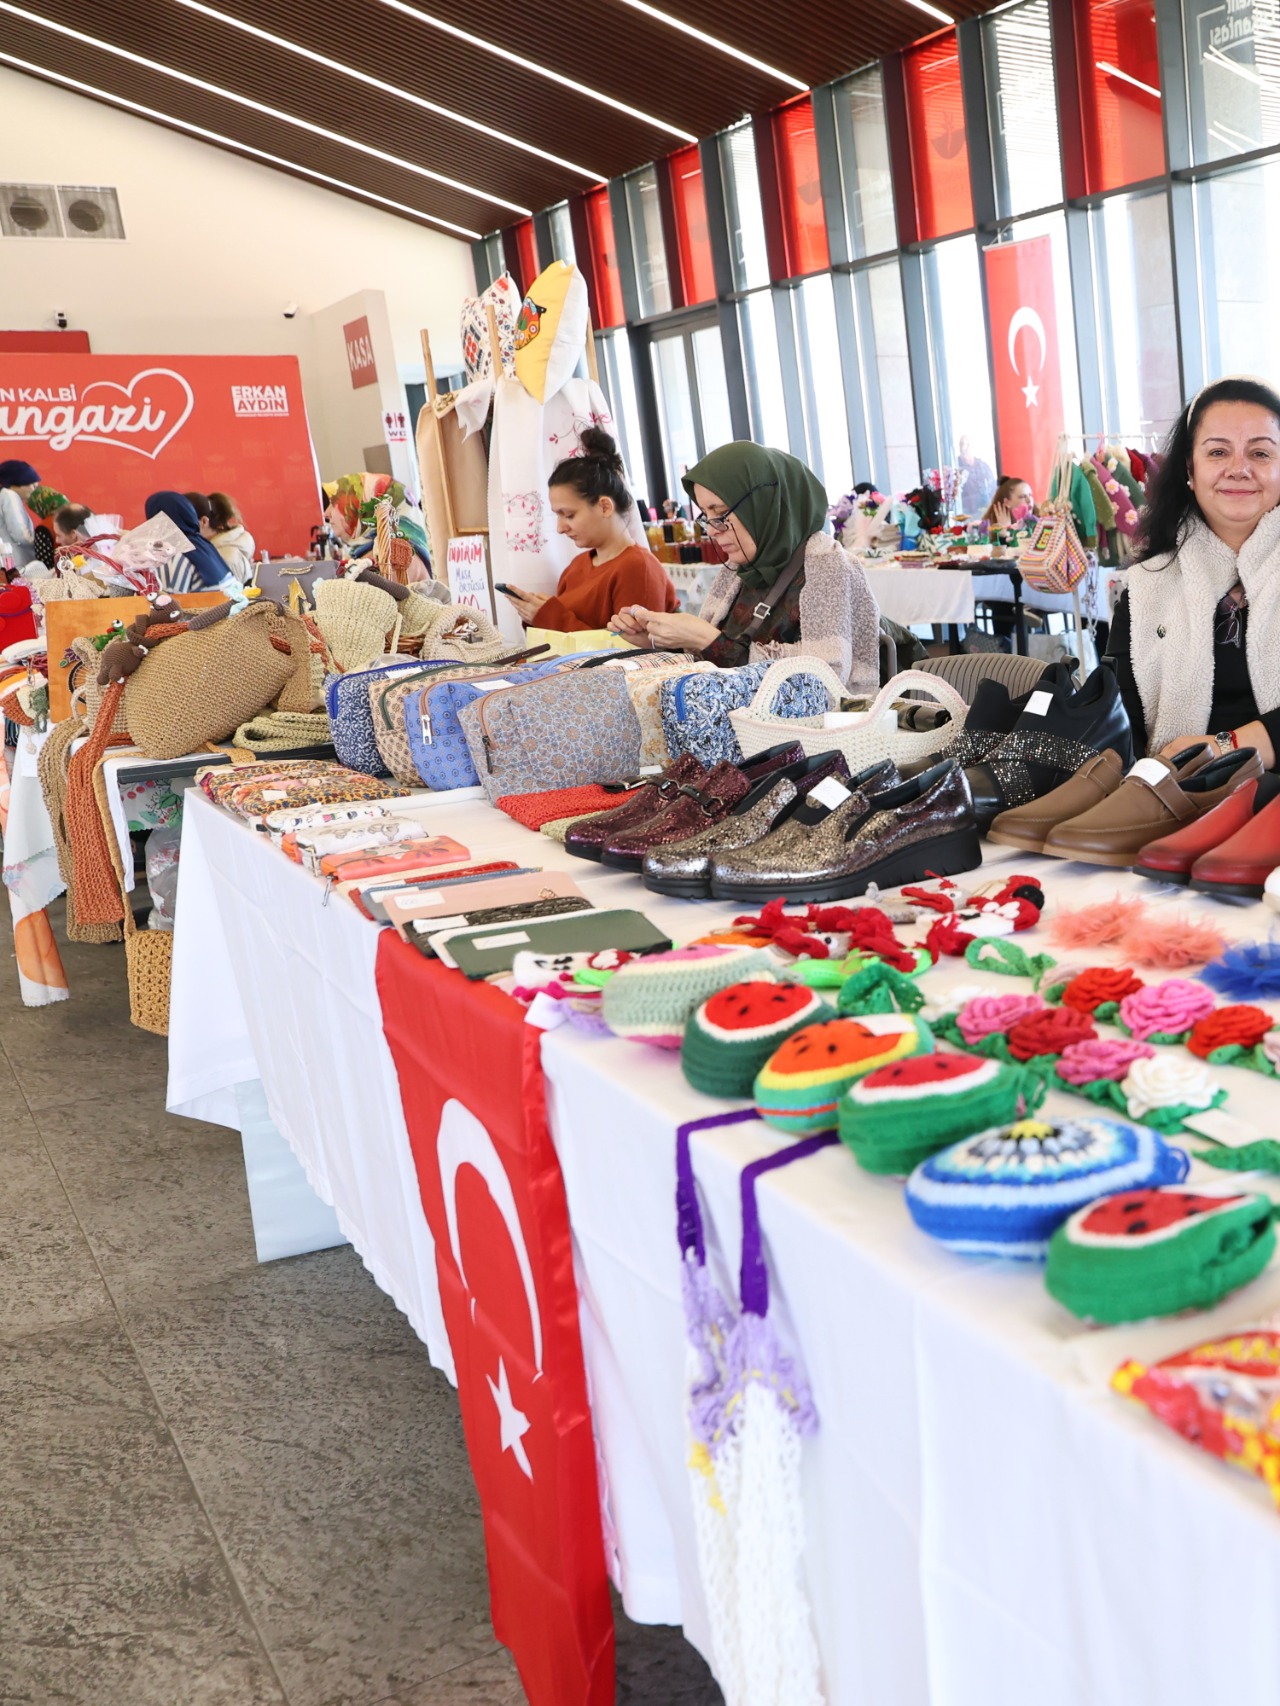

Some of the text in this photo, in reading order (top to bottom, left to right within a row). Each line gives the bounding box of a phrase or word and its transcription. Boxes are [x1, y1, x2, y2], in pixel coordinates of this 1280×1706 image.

[346, 335, 374, 371] KASA
[18, 383, 77, 402] KALBİ
[231, 385, 287, 399] ERKAN
[237, 399, 286, 412] AYDIN
[388, 430, 407, 438] WC
